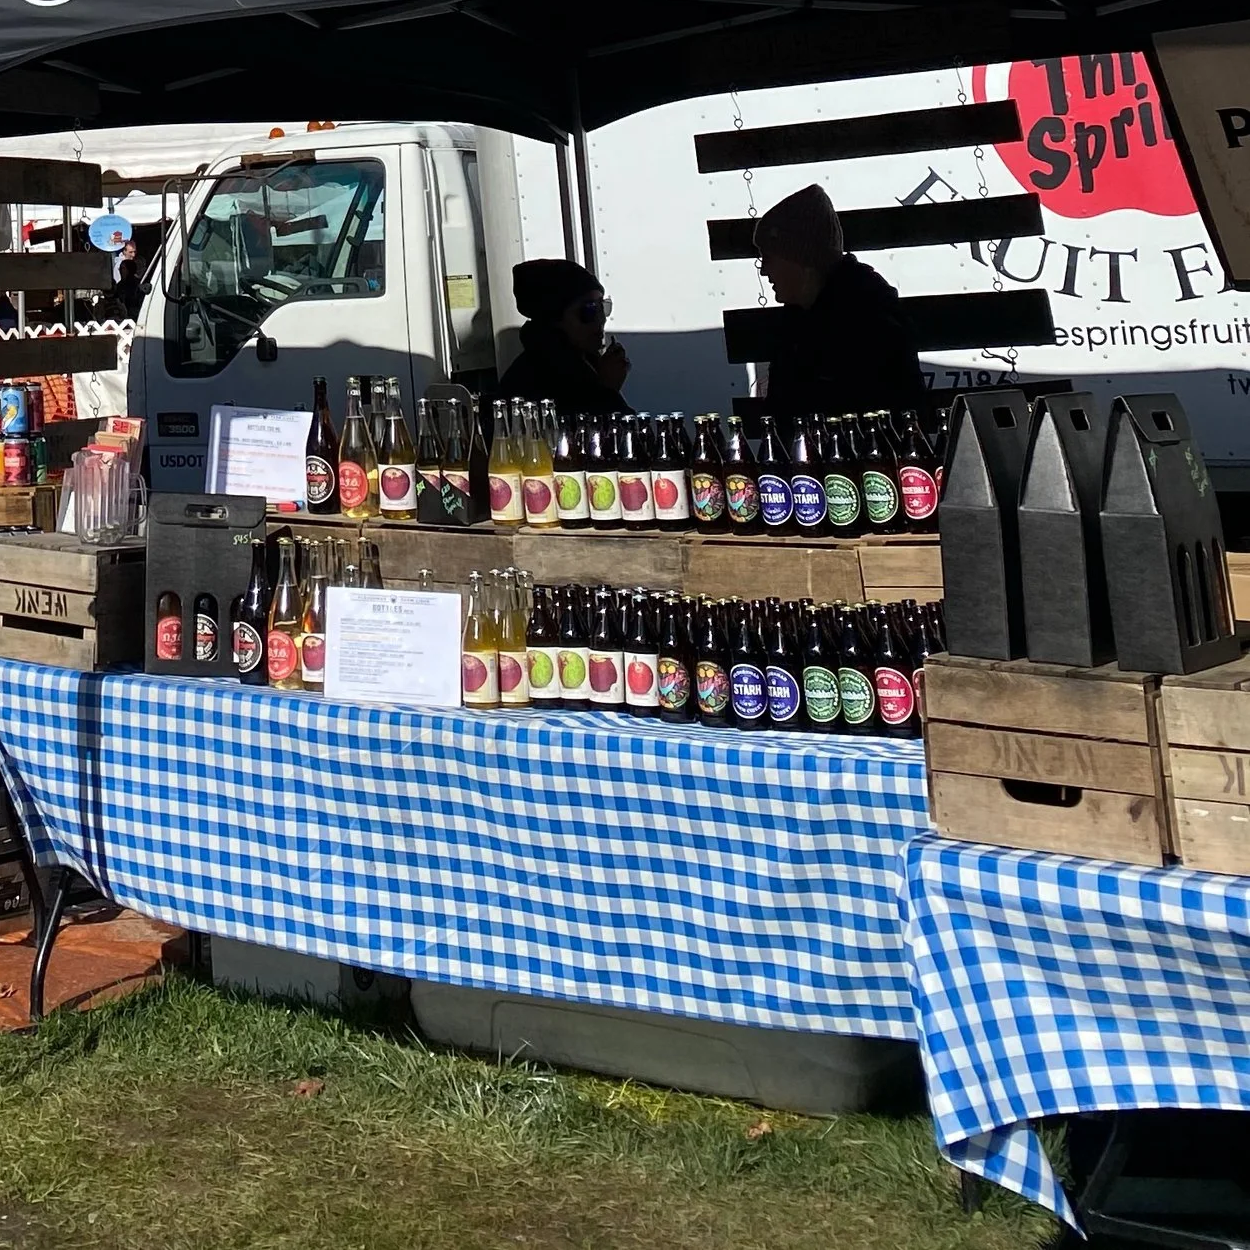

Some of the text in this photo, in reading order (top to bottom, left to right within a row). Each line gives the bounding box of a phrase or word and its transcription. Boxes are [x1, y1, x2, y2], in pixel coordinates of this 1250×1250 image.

[894, 166, 1138, 303] FUIT
[160, 454, 205, 469] USDOT
[14, 587, 68, 618] WENK
